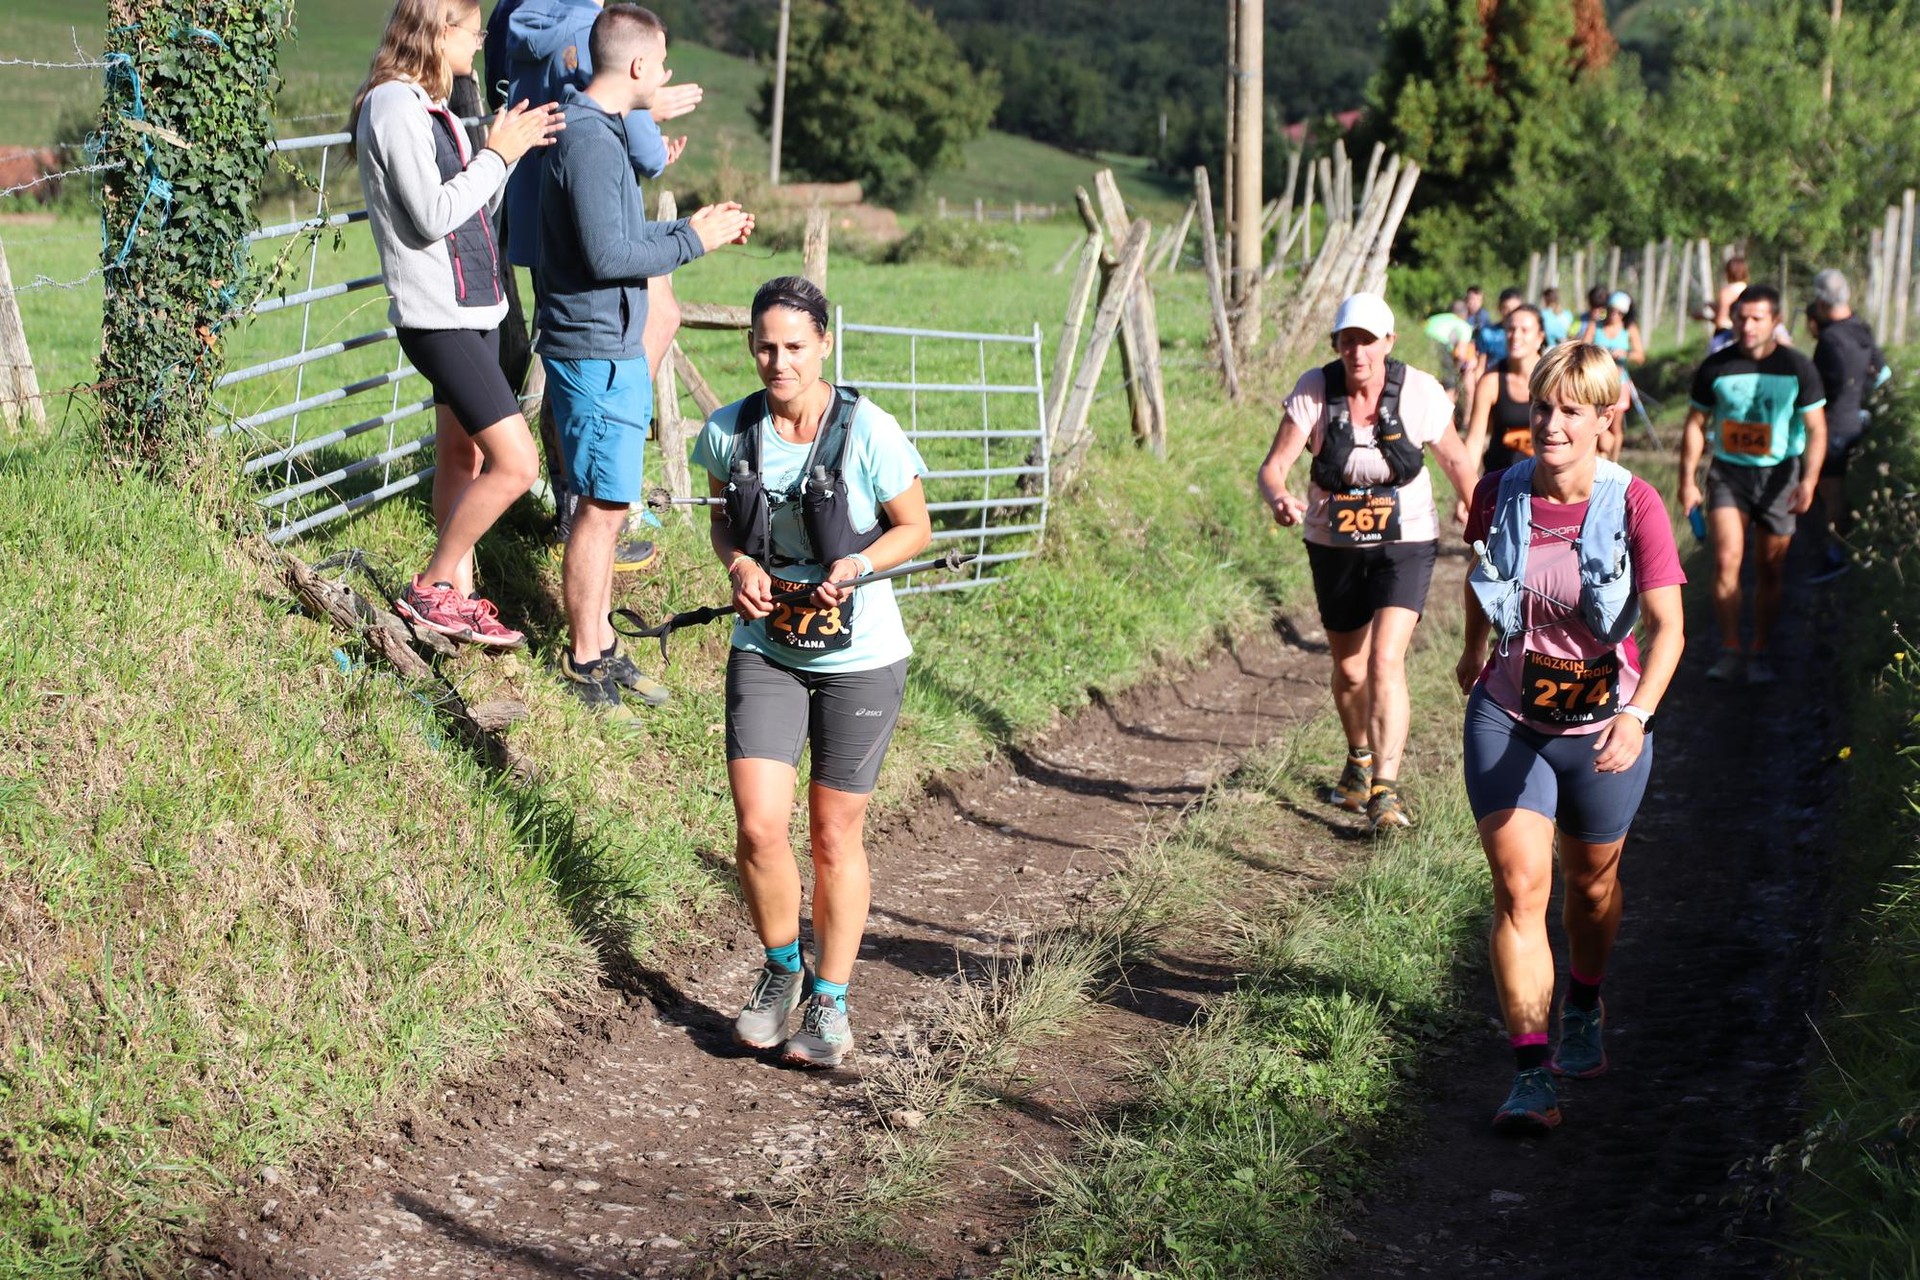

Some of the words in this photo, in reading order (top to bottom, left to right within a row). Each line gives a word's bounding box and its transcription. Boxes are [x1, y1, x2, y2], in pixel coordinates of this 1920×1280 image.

[1337, 507, 1393, 532] 267
[1361, 533, 1382, 541] LANA
[773, 602, 842, 636] 273
[798, 639, 826, 649] LANA
[1533, 678, 1610, 710] 274
[1565, 712, 1594, 722] LANA
